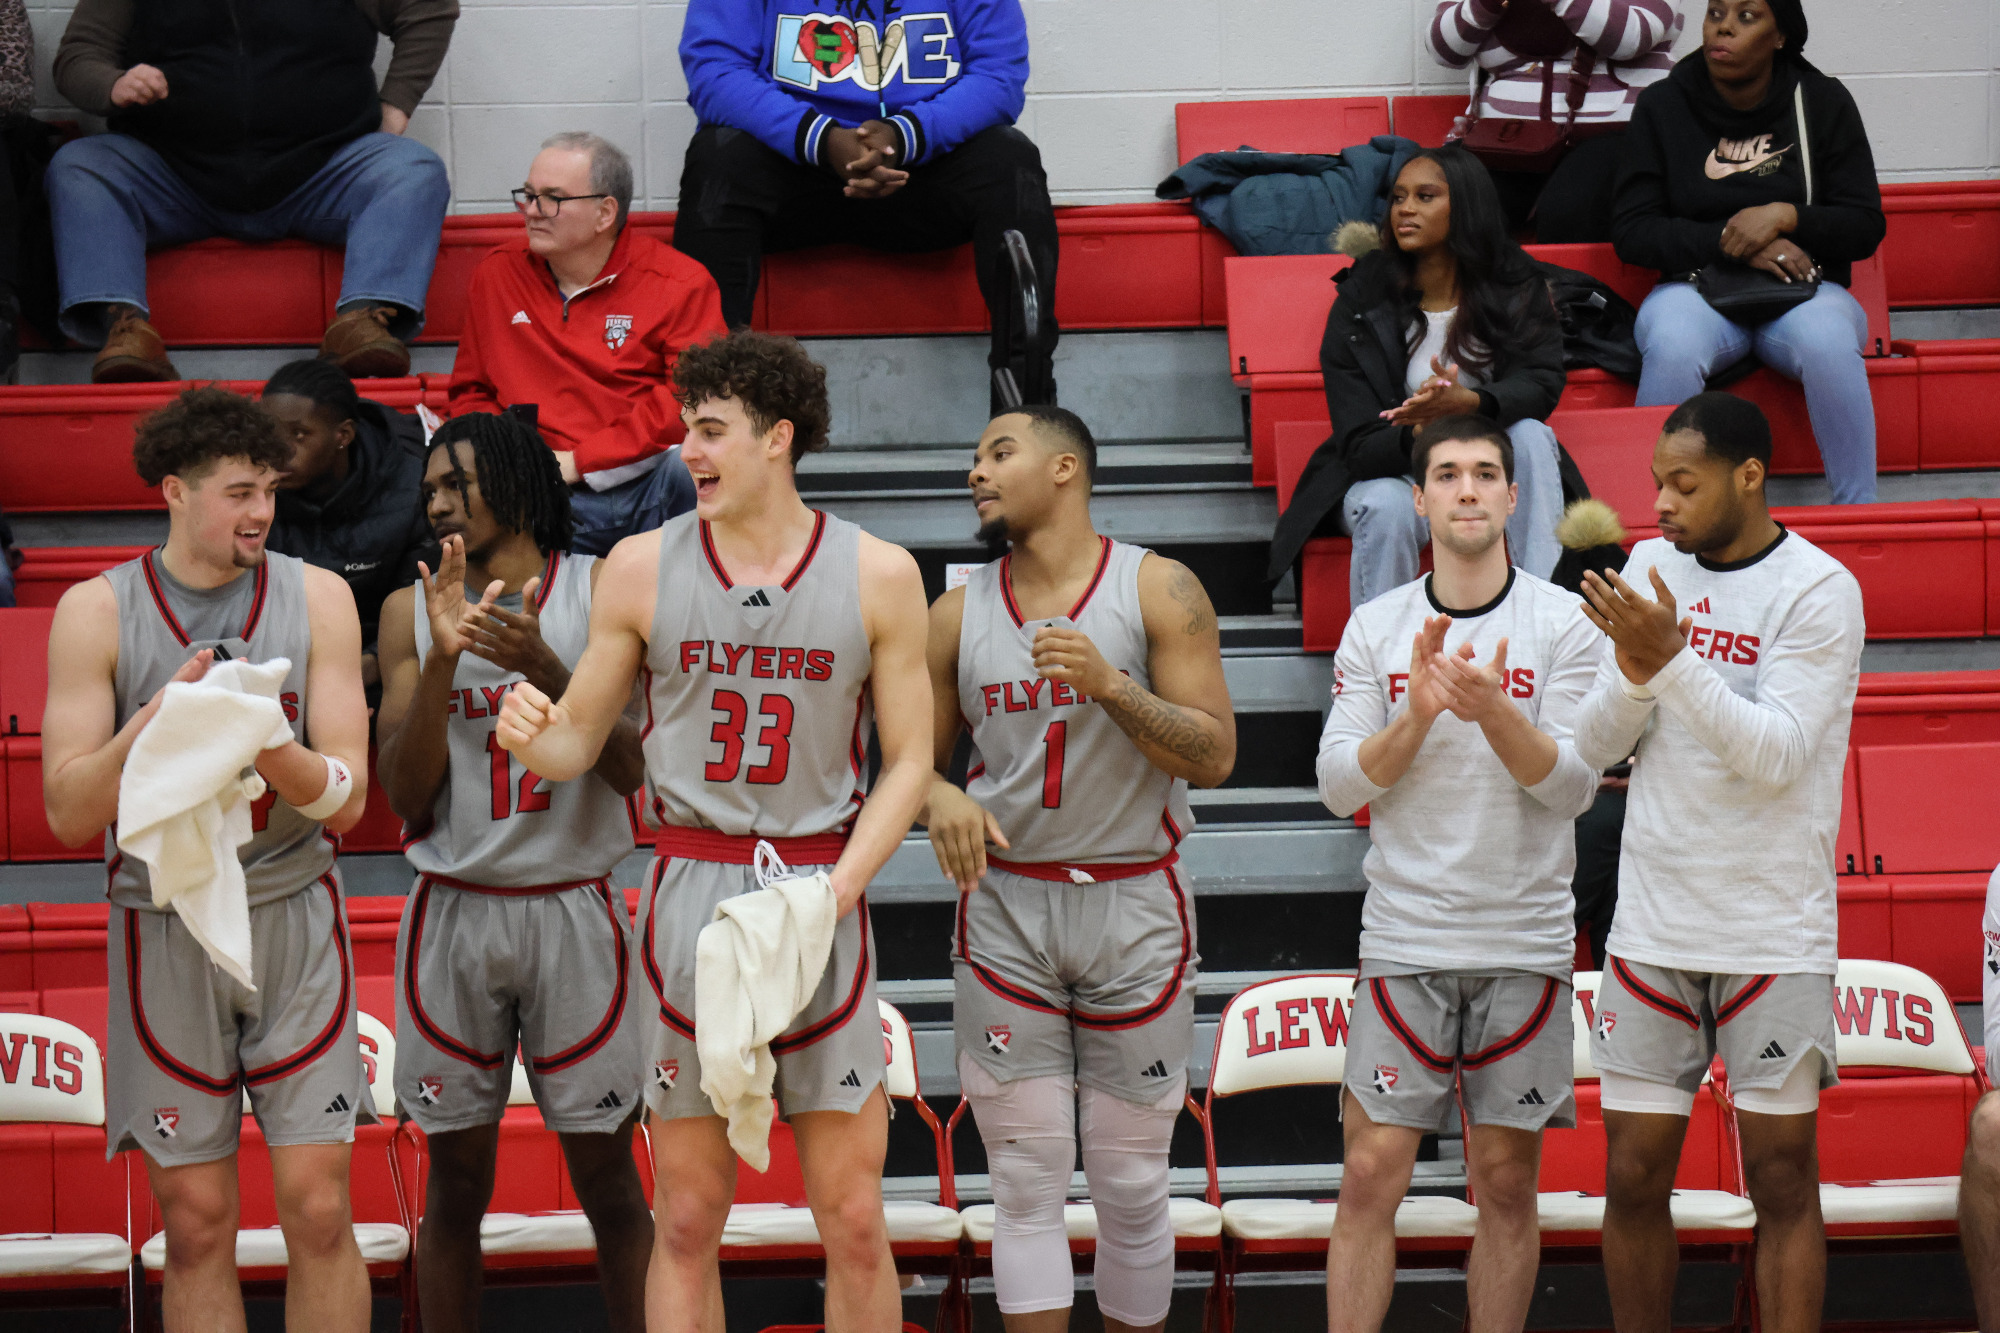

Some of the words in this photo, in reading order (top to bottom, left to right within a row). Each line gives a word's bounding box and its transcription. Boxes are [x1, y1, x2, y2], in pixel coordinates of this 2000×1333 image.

[773, 13, 961, 91] LOVE
[1717, 134, 1773, 161] NIKE
[680, 640, 835, 682] FLYERS
[448, 682, 521, 720] FLY
[705, 688, 795, 785] 33
[485, 731, 552, 820] 12
[1042, 720, 1067, 809] 1
